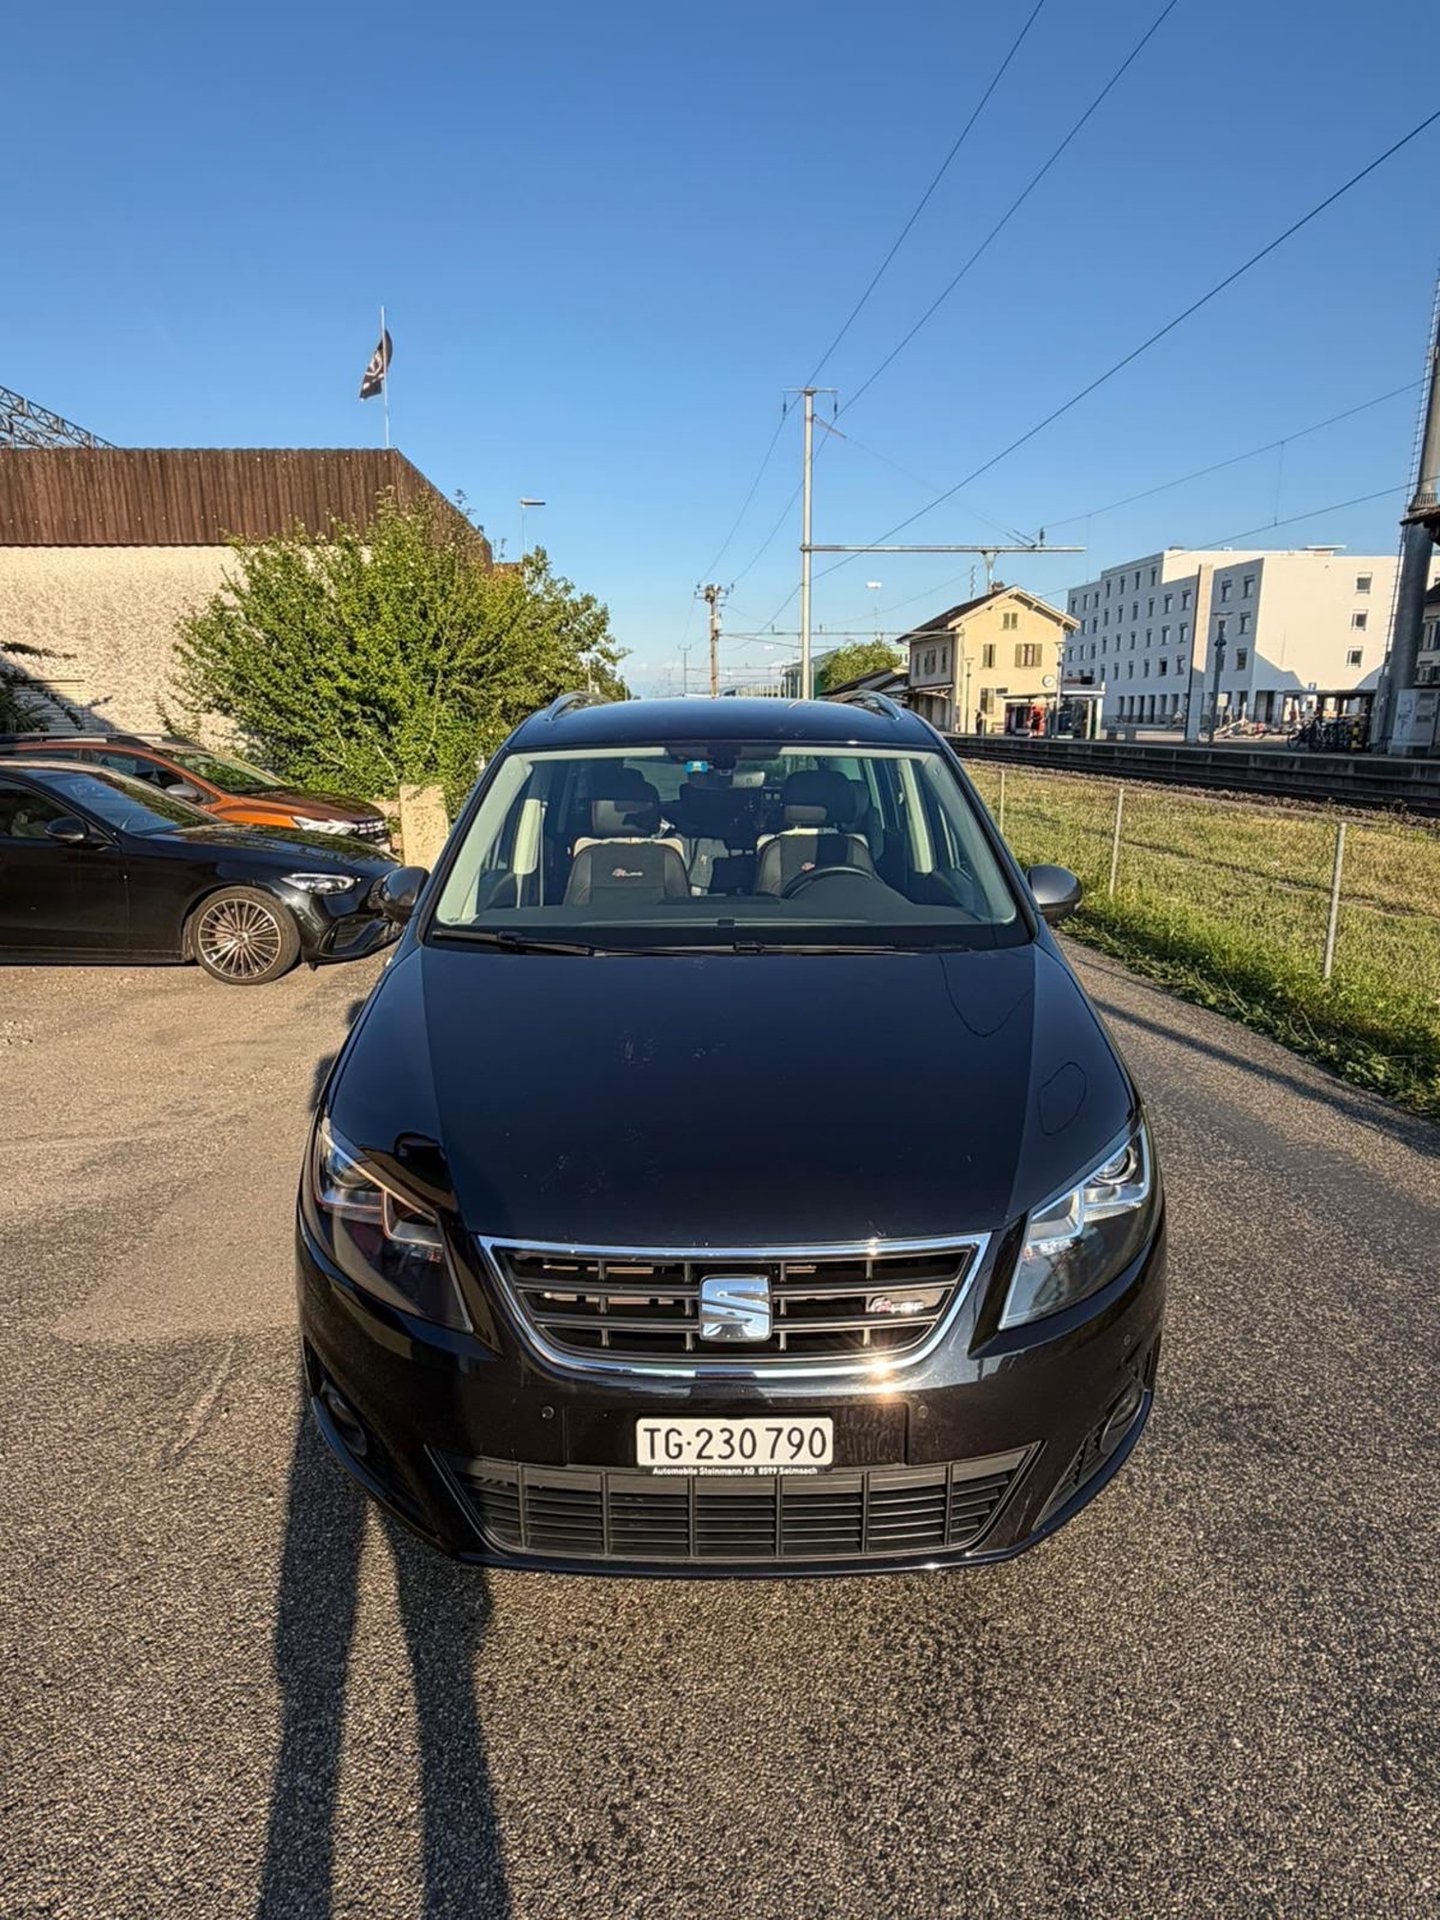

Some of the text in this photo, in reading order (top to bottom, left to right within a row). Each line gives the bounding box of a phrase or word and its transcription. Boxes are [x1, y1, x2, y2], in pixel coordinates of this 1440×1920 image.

[765, 1426, 827, 1460] 790
[652, 1466, 698, 1475] Automobile
[699, 1466, 742, 1475] Steinmann
[743, 1466, 755, 1475] AG
[779, 1466, 818, 1475] Salmsach
